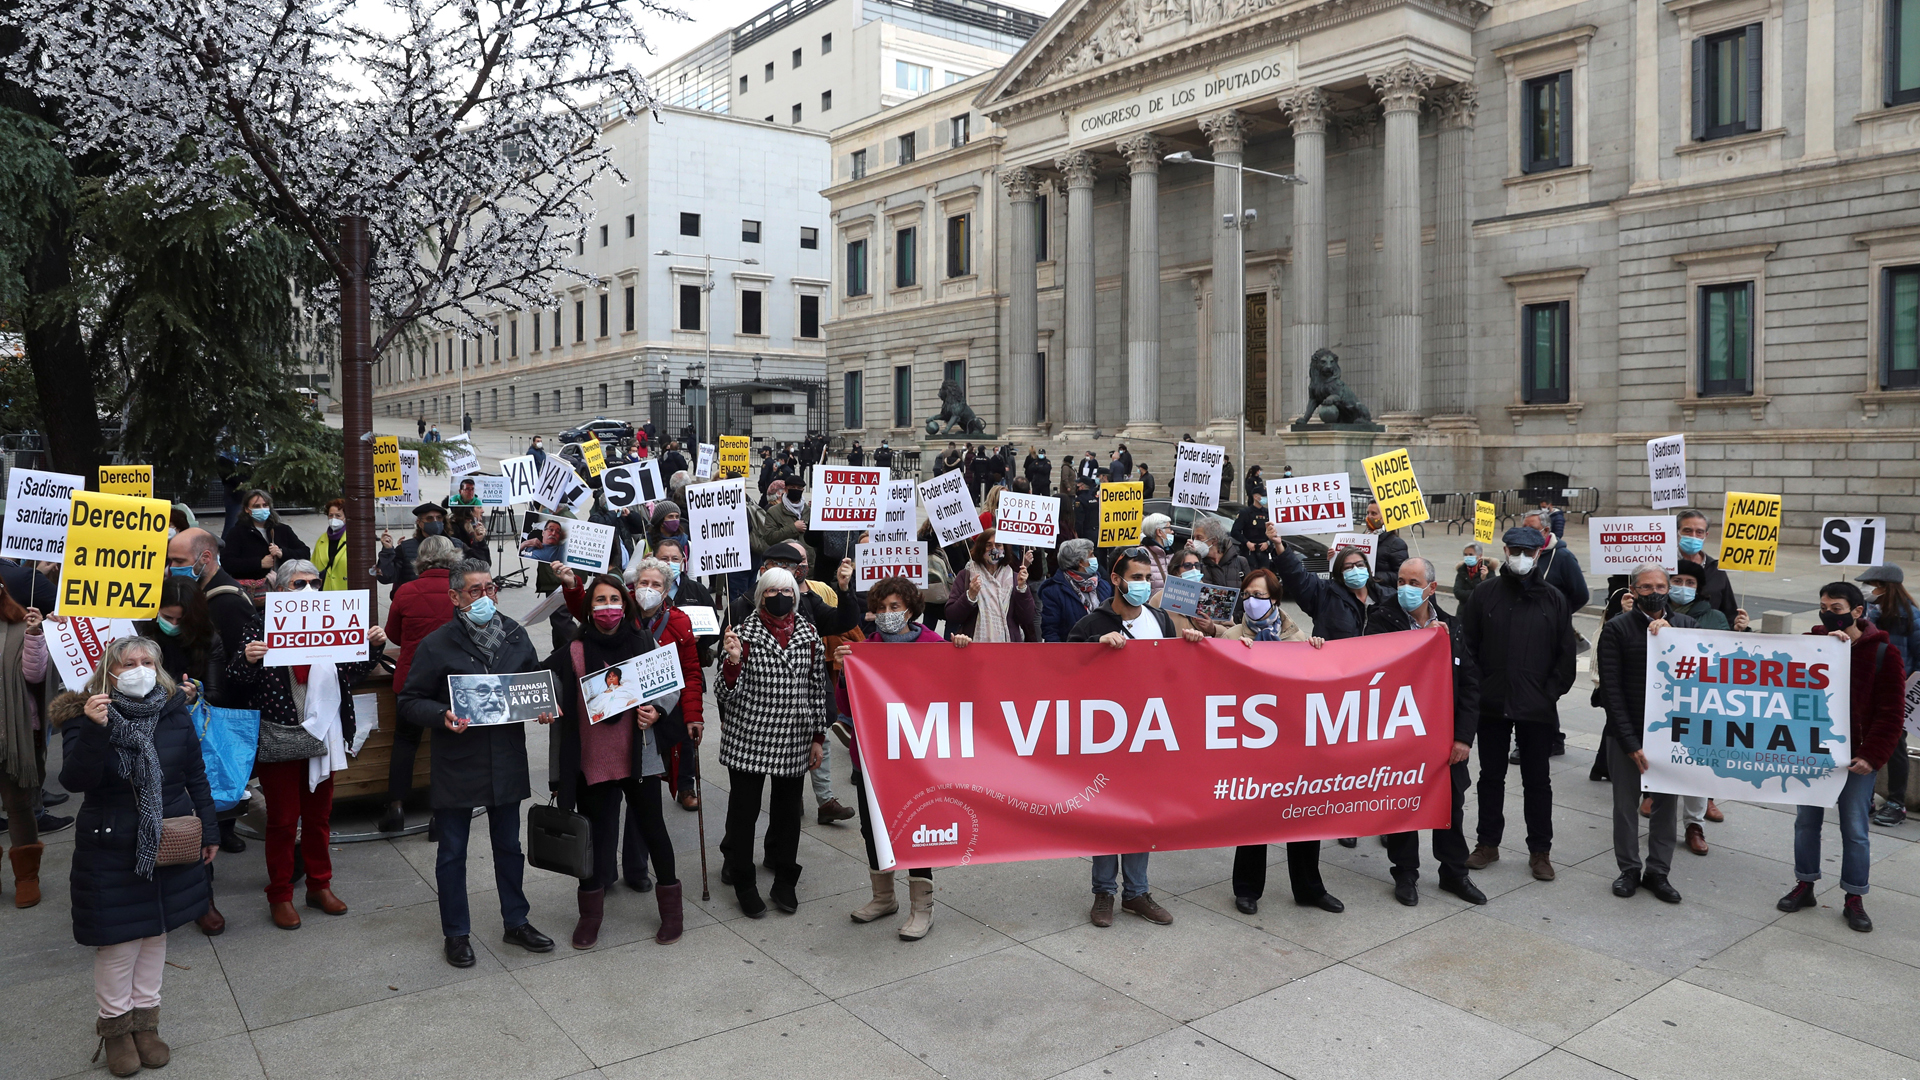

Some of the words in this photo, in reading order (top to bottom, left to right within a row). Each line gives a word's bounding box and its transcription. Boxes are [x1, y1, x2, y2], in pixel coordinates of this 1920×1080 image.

[1081, 104, 1141, 132] CONGRESO
[1149, 97, 1164, 114] DE
[1172, 88, 1196, 107] LOS
[1204, 62, 1281, 98] DIPUTADOS
[373, 442, 396, 455] echo
[583, 442, 600, 454] Derecho
[720, 439, 748, 449] Derecho
[1652, 442, 1680, 462] ¡Sadismo
[728, 453, 746, 462] morir
[1179, 445, 1200, 462] Poder
[1201, 448, 1221, 468] elegir
[100, 469, 150, 484] Derecho
[590, 466, 597, 474] EN
[720, 465, 730, 474] EN
[1183, 469, 1190, 482] el
[1192, 471, 1211, 485] morir
[1371, 455, 1409, 482] ¡NADIE
[1655, 463, 1682, 480] sanitario,
[378, 478, 400, 492] PAZ.
[504, 461, 535, 496] YA!
[539, 462, 566, 501] YA!
[605, 462, 656, 507] SÍ
[826, 472, 878, 484] BUENA
[17, 477, 74, 500] ¡Sadismo
[826, 485, 877, 495] VIDA
[892, 484, 912, 503] elegir
[920, 484, 942, 501] Poder
[943, 474, 962, 494] elegir
[1102, 487, 1142, 502] Derecho
[1275, 480, 1340, 495] #LIBRES
[1376, 477, 1418, 502] DECIDA
[1653, 488, 1670, 502] nunca
[1672, 484, 1686, 499] más!
[688, 488, 715, 510] Poder
[717, 484, 742, 510] elegir
[825, 497, 876, 507] BUENA
[1003, 497, 1036, 509] SOBRE
[1042, 502, 1054, 511] MI
[1178, 490, 1189, 504] sin
[1190, 492, 1210, 507] sufrir.
[1276, 495, 1319, 505] HASTA
[1328, 493, 1341, 501] EL
[72, 500, 166, 532] Derecho
[824, 508, 875, 519] MUERTE
[885, 507, 905, 522] morir
[936, 505, 944, 520] el
[944, 499, 963, 518] morir
[1003, 508, 1052, 524] VIDA
[1104, 512, 1110, 522] a
[1113, 507, 1138, 522] morir
[1277, 503, 1343, 522] FINAL
[1385, 505, 1410, 524] POR
[1410, 496, 1425, 516] TÍ!
[1476, 503, 1495, 516] Derecho
[1730, 499, 1779, 518] ¡NADIE
[701, 519, 709, 540] el
[711, 516, 734, 538] morir
[1001, 521, 1037, 532] DECIDO
[1038, 525, 1052, 535] YO
[1480, 516, 1493, 528] morir
[1603, 523, 1634, 532] VIVIR
[1649, 523, 1662, 531] ES
[875, 531, 885, 542] sin
[888, 528, 909, 542] sufrir.
[942, 527, 955, 542] sin
[953, 520, 975, 538] sufrir.
[1101, 529, 1115, 542] EN
[1118, 527, 1138, 541] PAZ.
[1475, 529, 1482, 539] EN
[1621, 534, 1662, 542] DERECHO
[1726, 522, 1778, 542] DECIDA
[6, 535, 43, 552] nunca
[46, 536, 64, 554] má
[570, 538, 606, 549] SALVARTE
[1604, 545, 1622, 553] NO
[1634, 544, 1663, 552] UNA
[1822, 519, 1875, 565] SÍ
[74, 546, 87, 566] a
[95, 544, 156, 570] morir
[700, 550, 714, 572] sin
[715, 546, 742, 570] sufrir.
[862, 546, 920, 557] #LIBRES
[1604, 554, 1663, 563] OBLIGACIÓN
[1722, 547, 1754, 564] POR
[1758, 546, 1774, 566] TÍ!
[862, 557, 900, 565] HASTA
[864, 566, 920, 579] FINAL
[65, 579, 99, 606] EN
[106, 581, 155, 608] PAZ.
[274, 599, 330, 613] SOBRE
[342, 598, 360, 610] MI
[273, 614, 360, 630] VIDA
[76, 616, 100, 657] CUÁNDO
[273, 632, 335, 647] DECIDO
[339, 631, 360, 644] YO
[57, 622, 88, 677] DECIDO
[656, 650, 671, 659] VIDA
[638, 667, 656, 676] TIENE
[660, 661, 673, 669] QUE
[639, 665, 675, 683] METERSE
[1674, 656, 1830, 690] #LIBRES
[509, 682, 547, 692] EUTANASIA
[640, 671, 676, 690] NADIE
[511, 693, 550, 706] AMOR
[886, 701, 975, 760] MI
[1000, 697, 1180, 756] VIDA
[1205, 693, 1279, 750] ES
[1305, 672, 1427, 747] MÍA
[1671, 717, 1830, 754] FINAL
[1671, 745, 1750, 761] ASOCIACIÓN
[1755, 752, 1817, 766] DERECHO
[1822, 758, 1830, 767] A
[1671, 755, 1719, 768] MORIR
[1726, 760, 1829, 775] DIGNAMENTE
[1213, 762, 1426, 801] #libreshastaelfinal
[972, 784, 984, 793] BIZI
[985, 788, 1005, 802] VIURE
[1007, 796, 1028, 812] VIVIR
[1030, 803, 1048, 815] BIZI
[1049, 796, 1083, 815] VIURE
[1079, 773, 1110, 802] VIVIR
[944, 796, 963, 807] MORIR
[962, 804, 978, 833] MORRER
[1282, 795, 1422, 820] derechoamorir.org
[912, 822, 958, 844] dmd
